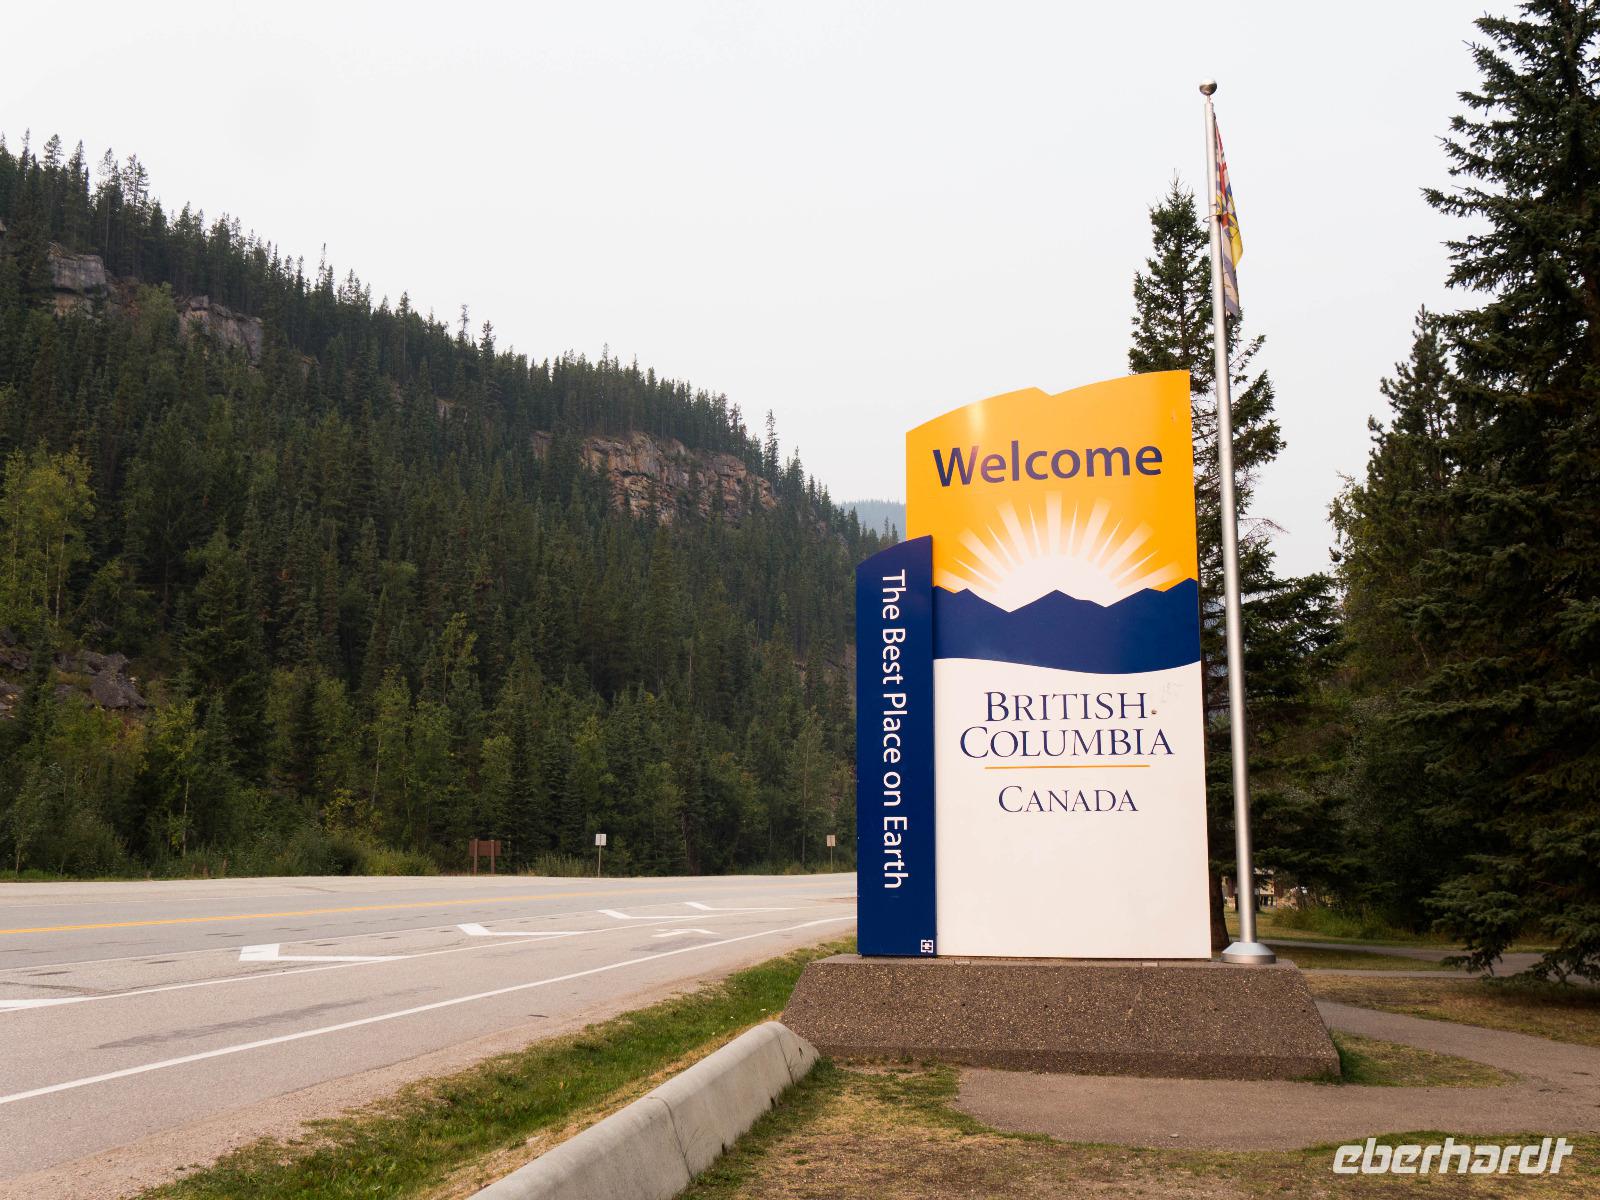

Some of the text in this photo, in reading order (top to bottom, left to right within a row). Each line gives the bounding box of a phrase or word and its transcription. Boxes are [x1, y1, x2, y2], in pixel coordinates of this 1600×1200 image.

[932, 439, 1163, 488] Welcome
[984, 691, 1149, 722] BRITISH
[882, 568, 909, 889] The Best Place on Earth
[960, 726, 1175, 759] COLUMBIA
[998, 785, 1139, 813] CANADA
